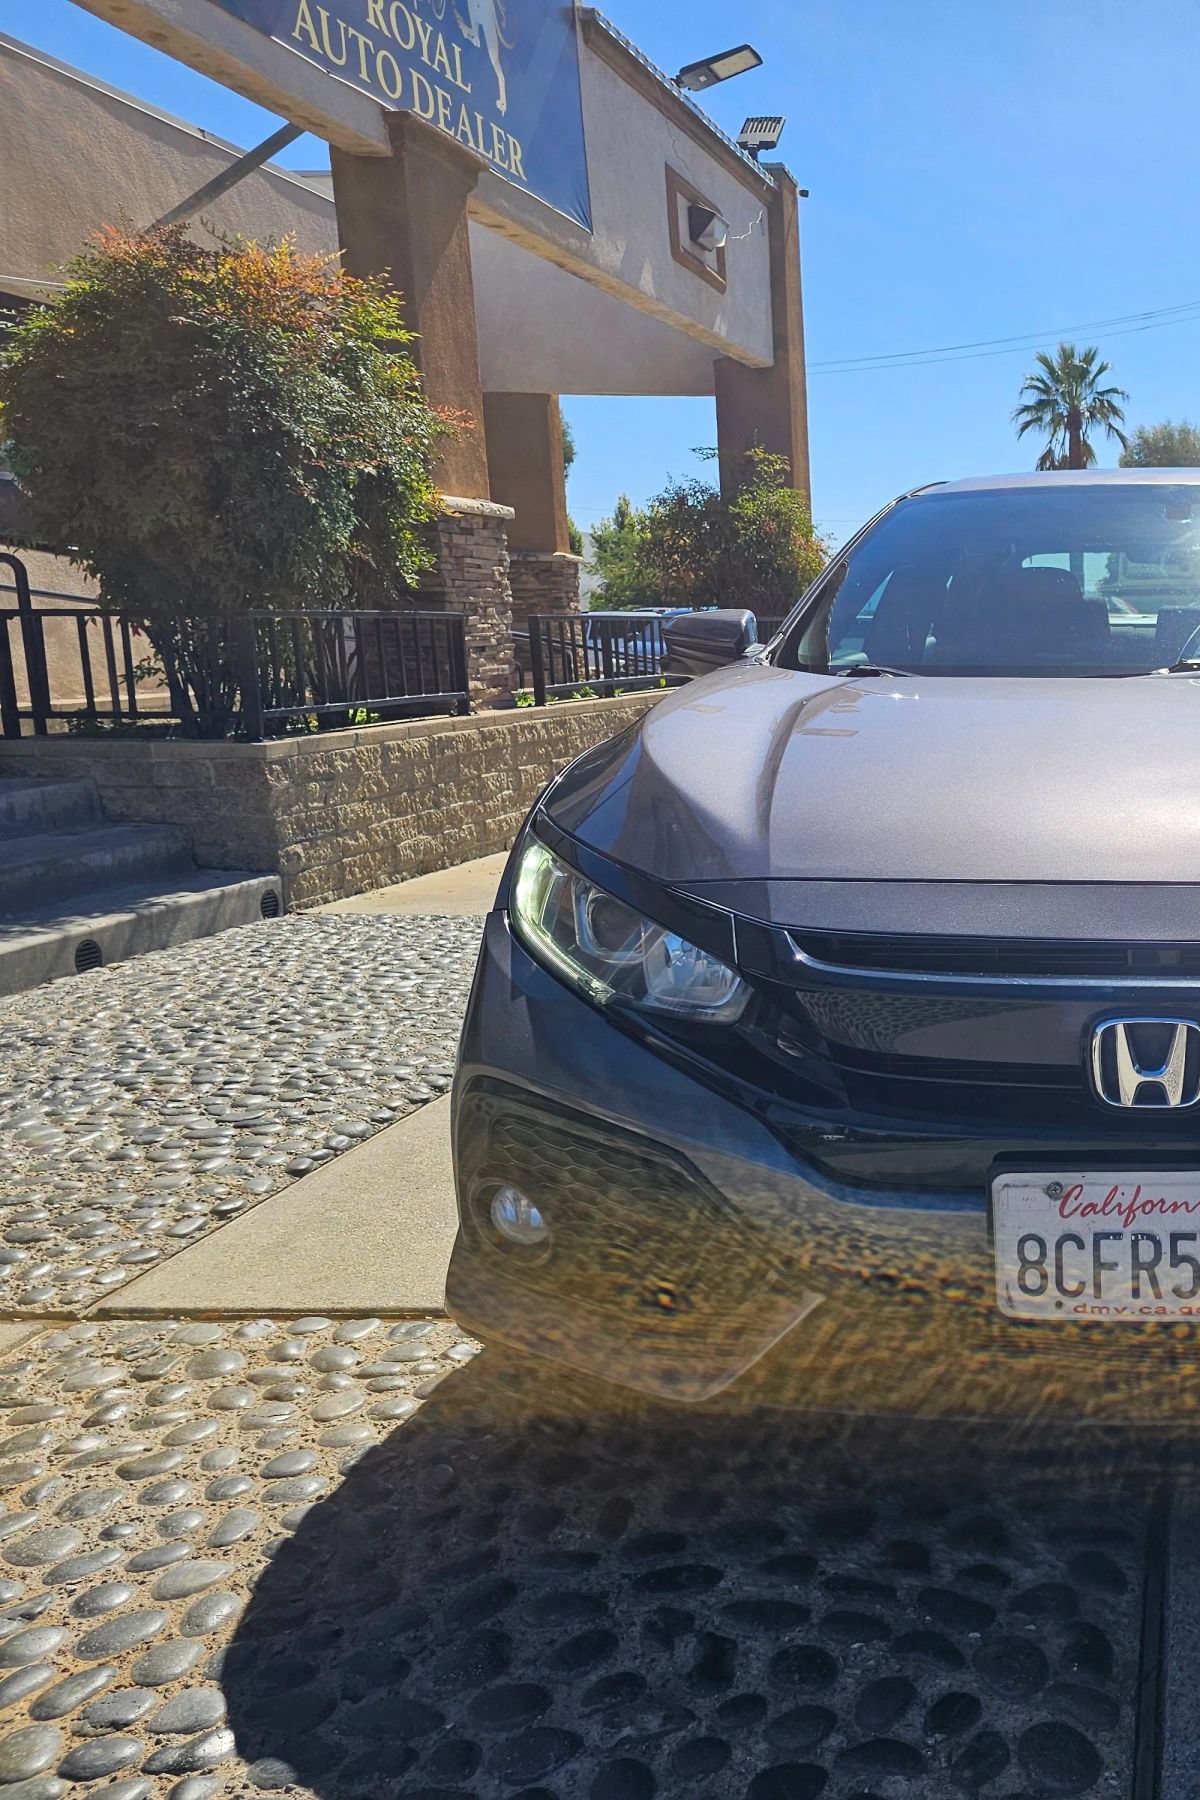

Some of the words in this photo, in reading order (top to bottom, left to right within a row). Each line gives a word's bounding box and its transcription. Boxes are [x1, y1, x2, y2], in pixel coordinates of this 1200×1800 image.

[291, 0, 403, 99] AUTO
[409, 68, 527, 181] DEALER
[366, 0, 472, 94] ROYAL
